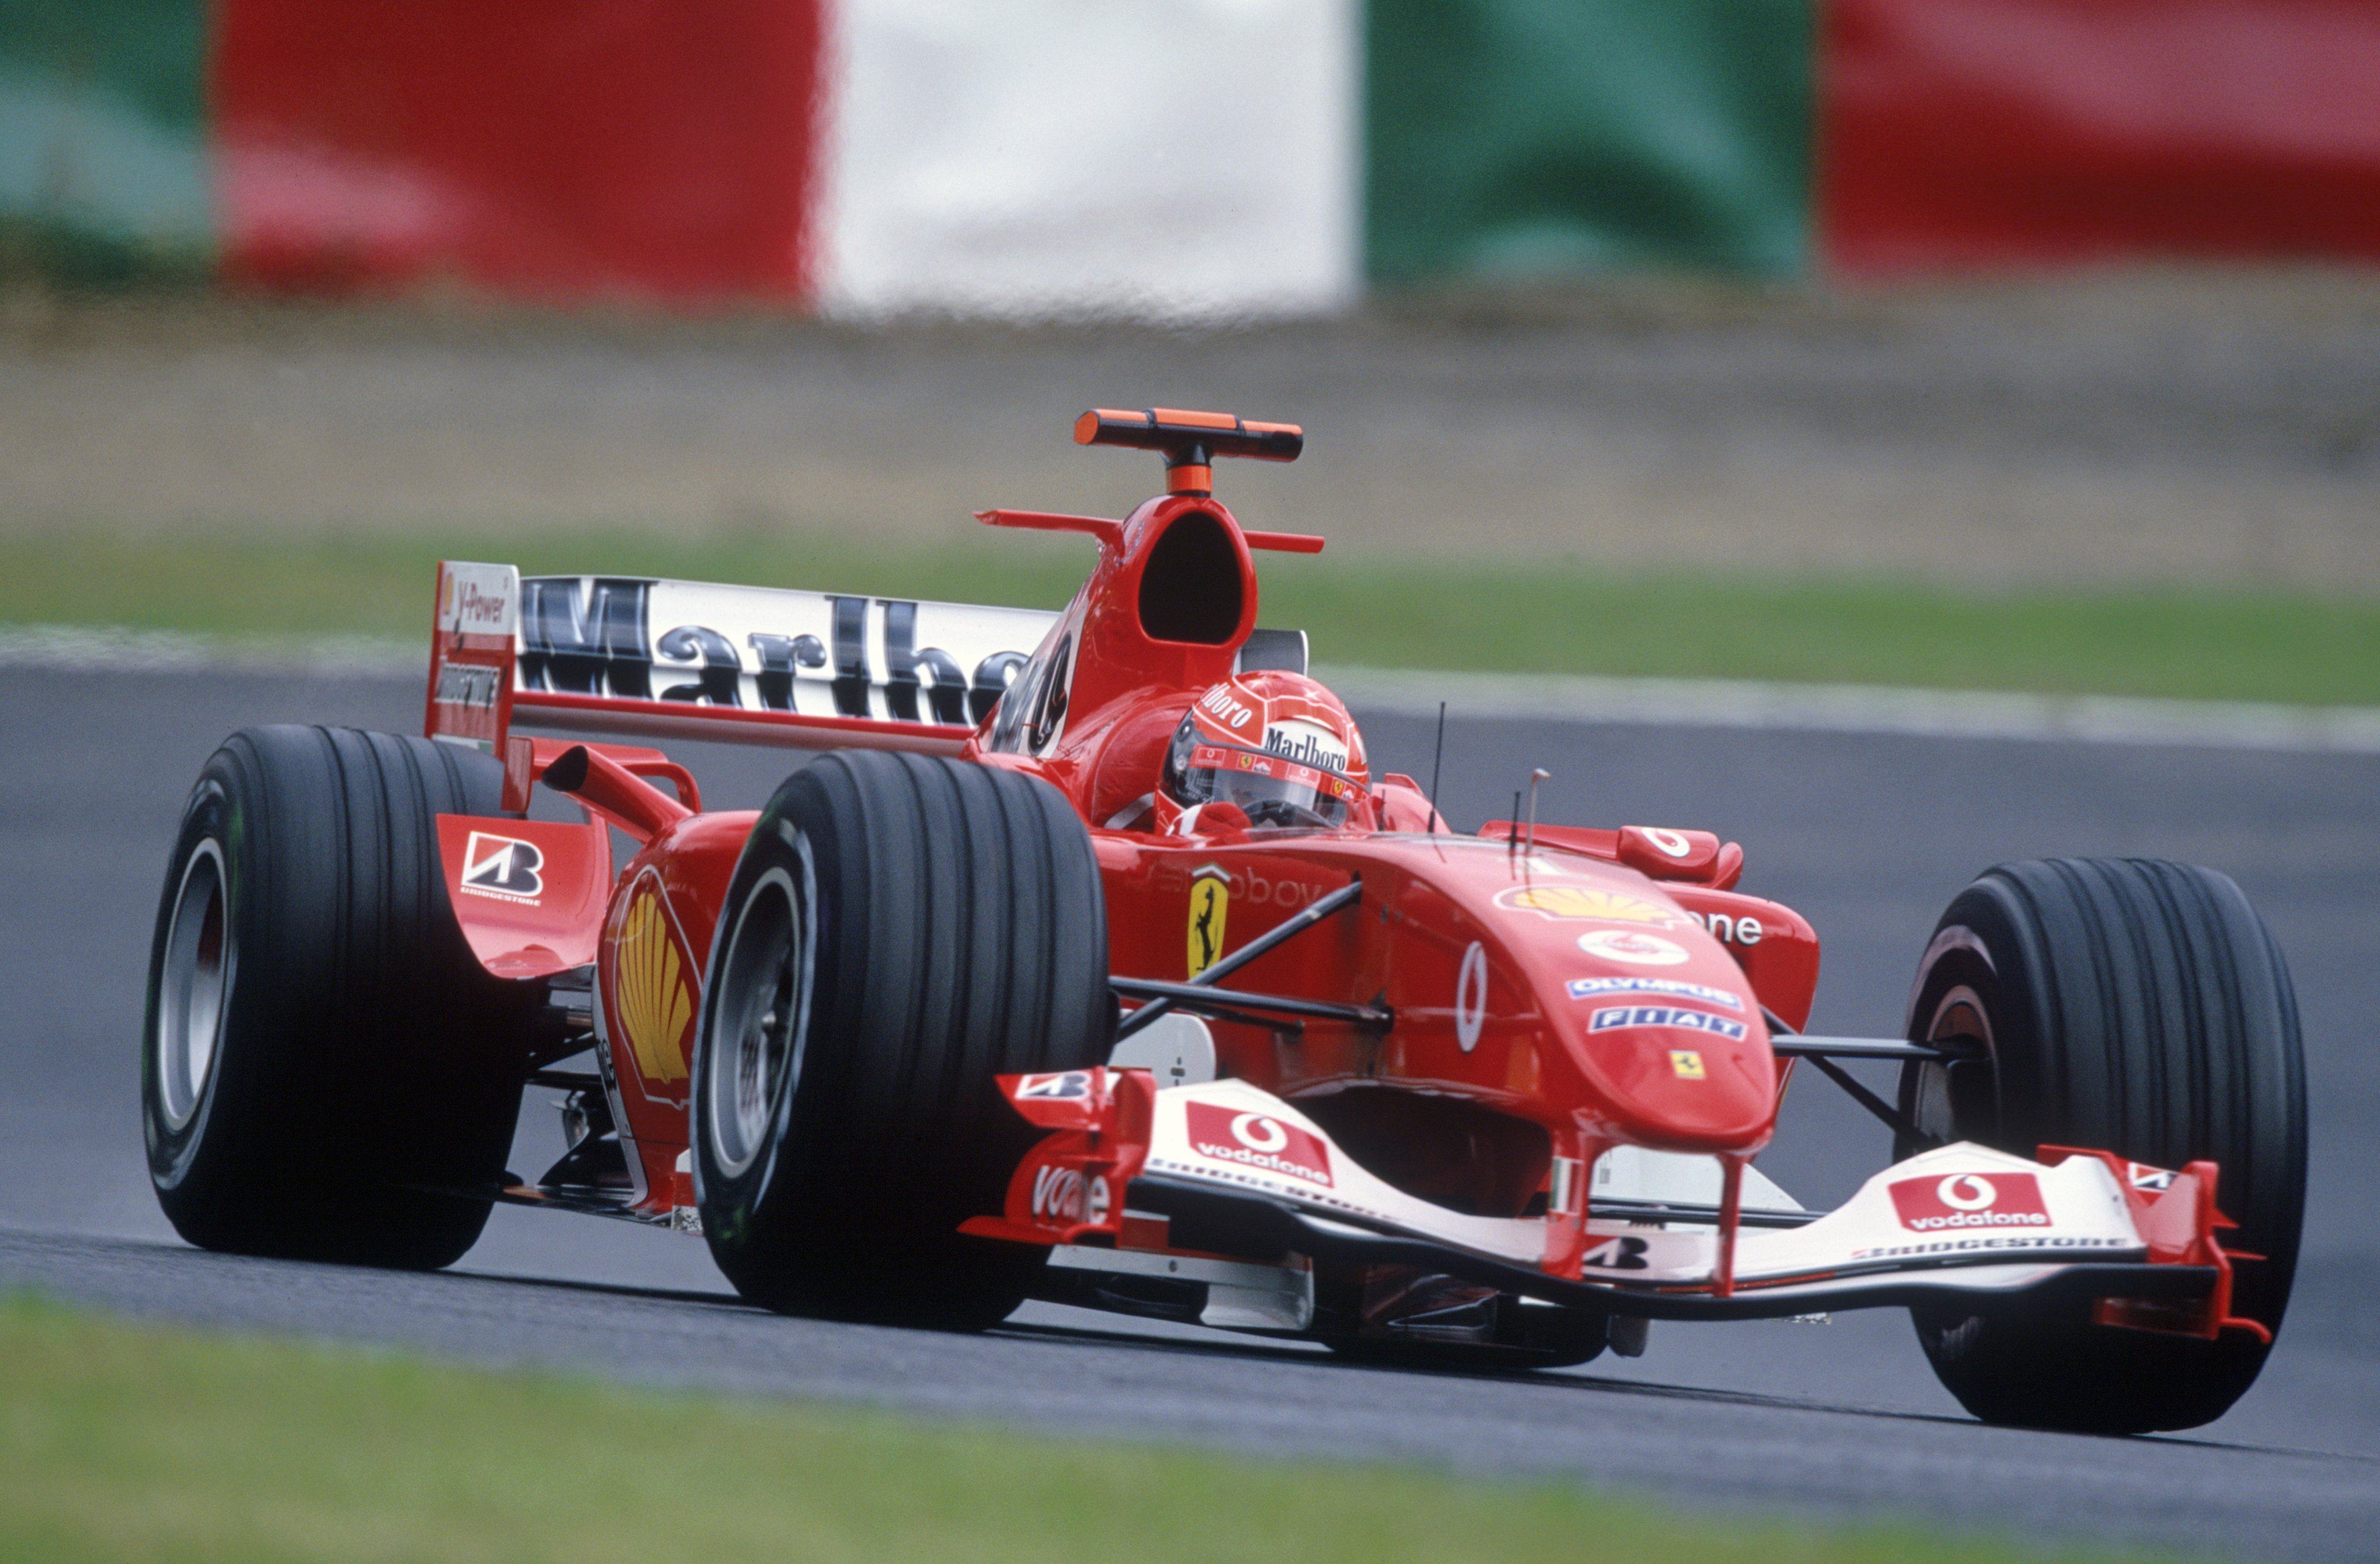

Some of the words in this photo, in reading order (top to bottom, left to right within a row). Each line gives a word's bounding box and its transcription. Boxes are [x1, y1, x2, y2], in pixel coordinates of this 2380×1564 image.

[1265, 726, 1346, 772] Marlboro
[460, 886, 542, 907] BRIDGESTONE
[1572, 978, 1740, 1005] OLYMPUS
[1601, 1010, 1736, 1033] FIAT
[1197, 1142, 1329, 1184] vodafone
[1909, 1211, 2047, 1230] vodafone
[1852, 1237, 2127, 1260] BRIDGESTONE
